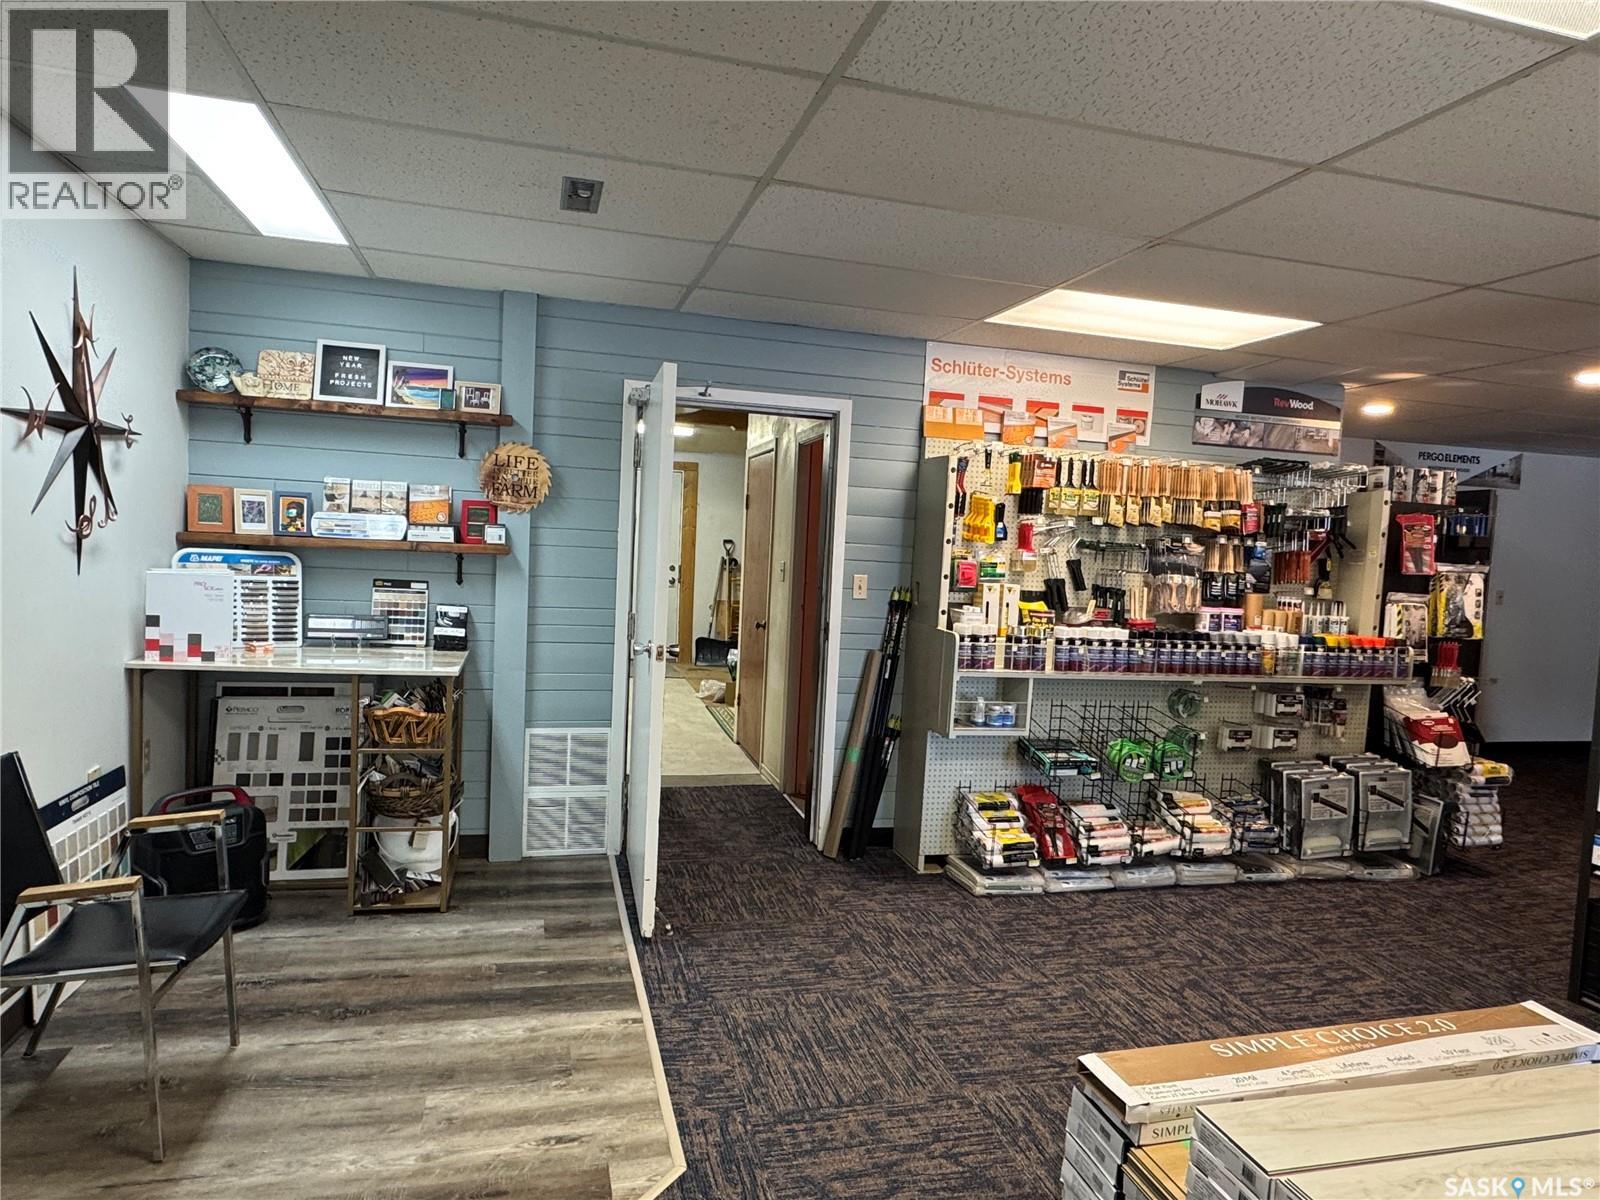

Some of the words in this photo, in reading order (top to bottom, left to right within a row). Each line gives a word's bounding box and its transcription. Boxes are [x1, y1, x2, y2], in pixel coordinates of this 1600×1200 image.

[340, 361, 362, 369] YEAR
[931, 357, 1072, 386] Schlüter-Systems
[334, 372, 366, 380] FRESH
[329, 379, 373, 388] PROJECTS
[1206, 398, 1238, 409] MOHAWK
[1273, 397, 1314, 410] RevWood
[493, 453, 539, 470] LIFE
[1418, 451, 1444, 462] PERGO
[1444, 453, 1481, 465] ELEMENTS
[492, 482, 538, 499] FARM
[200, 554, 224, 563] MAPEI
[1209, 1033, 1317, 1057] SIMPLE
[1315, 1022, 1421, 1045] CHOICE
[1416, 1018, 1457, 1033] 2.0
[1511, 1055, 1550, 1069] CHOICE
[1554, 1050, 1590, 1063] SIMPLE
[1152, 1124, 1192, 1139] SIMPL
